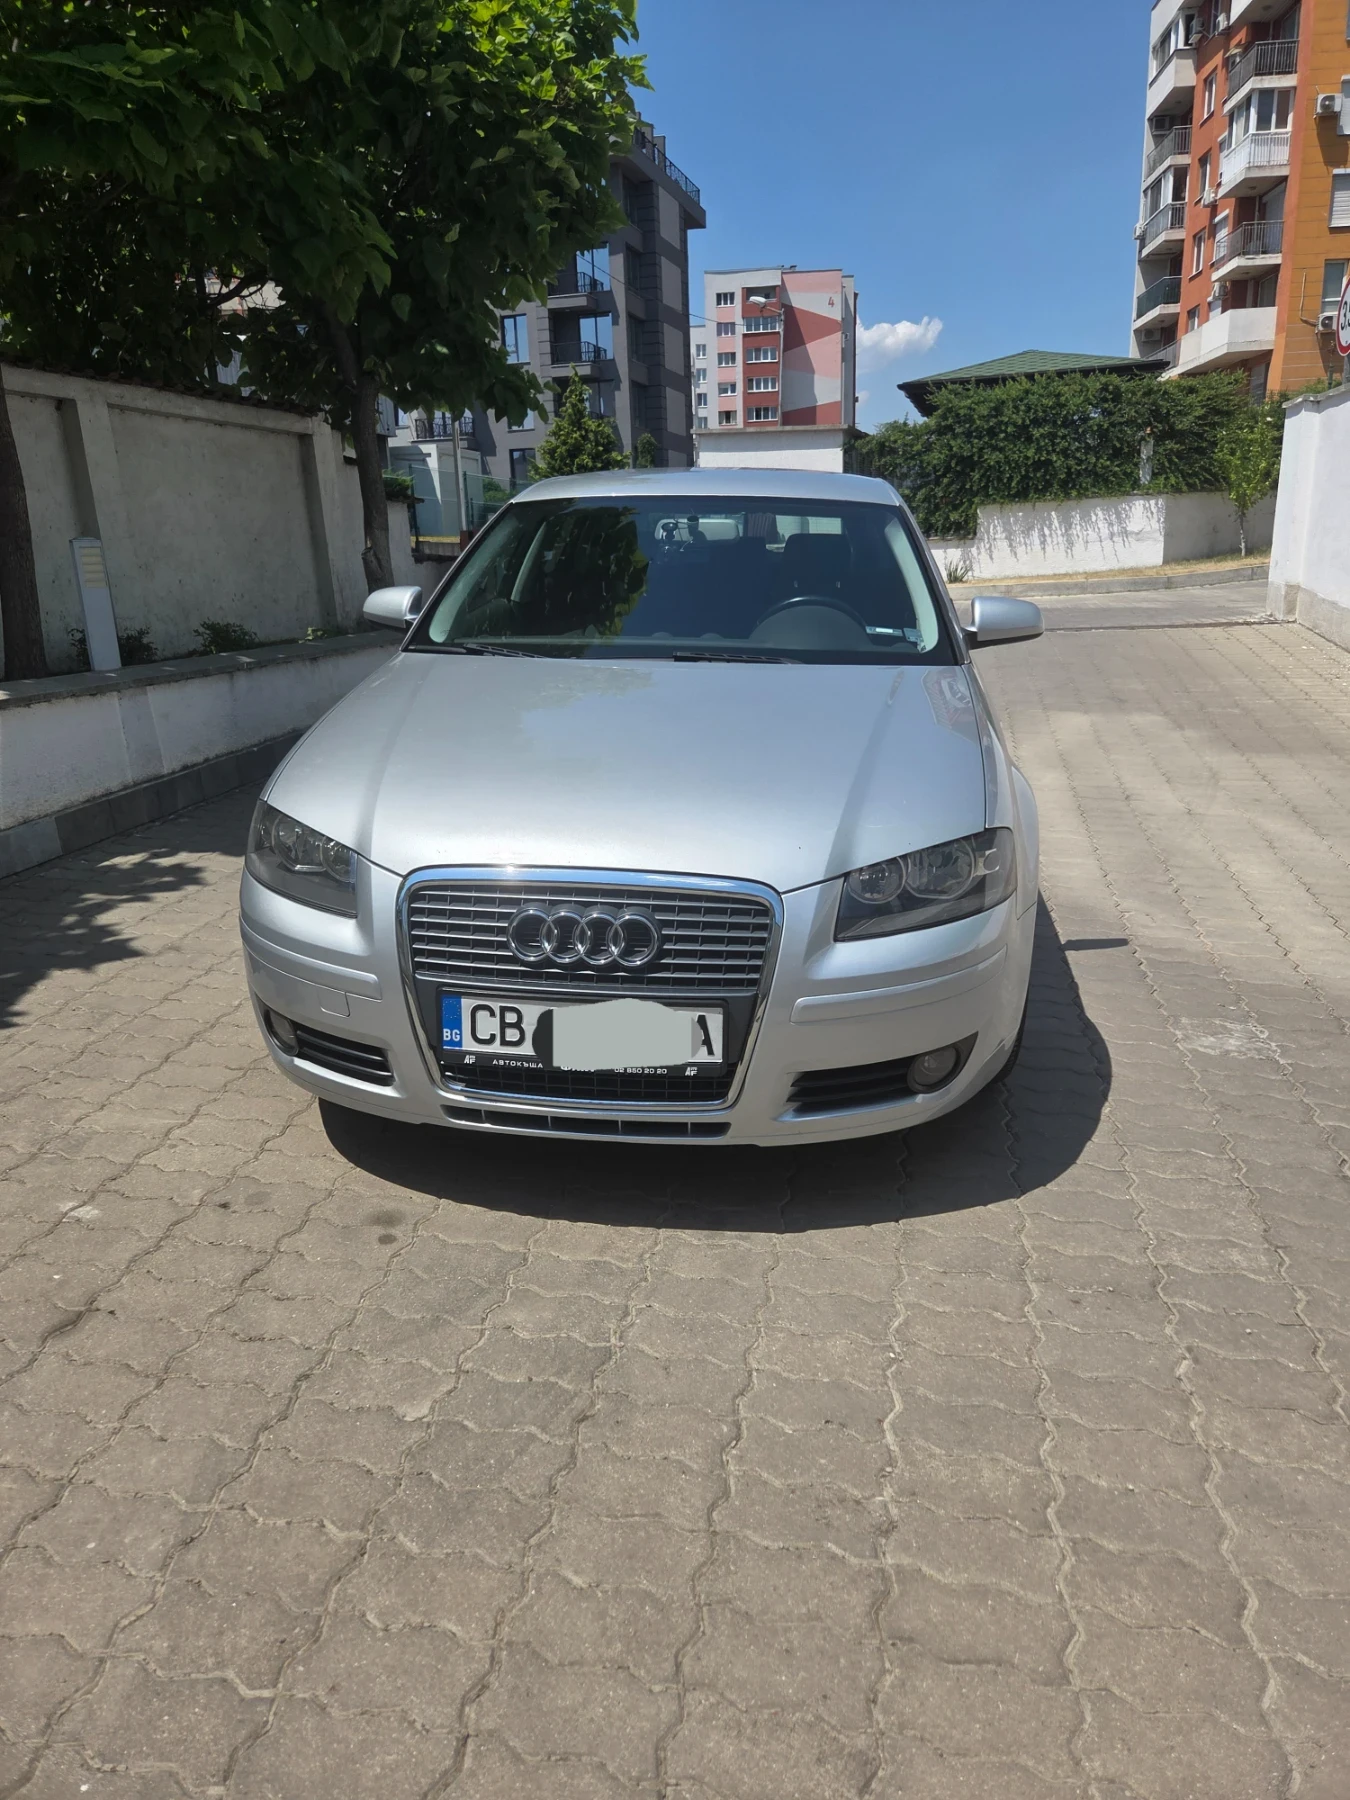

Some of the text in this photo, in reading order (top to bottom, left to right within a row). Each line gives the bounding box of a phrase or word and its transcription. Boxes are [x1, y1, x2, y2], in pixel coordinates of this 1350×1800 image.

[828, 296, 835, 308] 4
[470, 1003, 526, 1048] CB
[443, 1028, 461, 1042] BG
